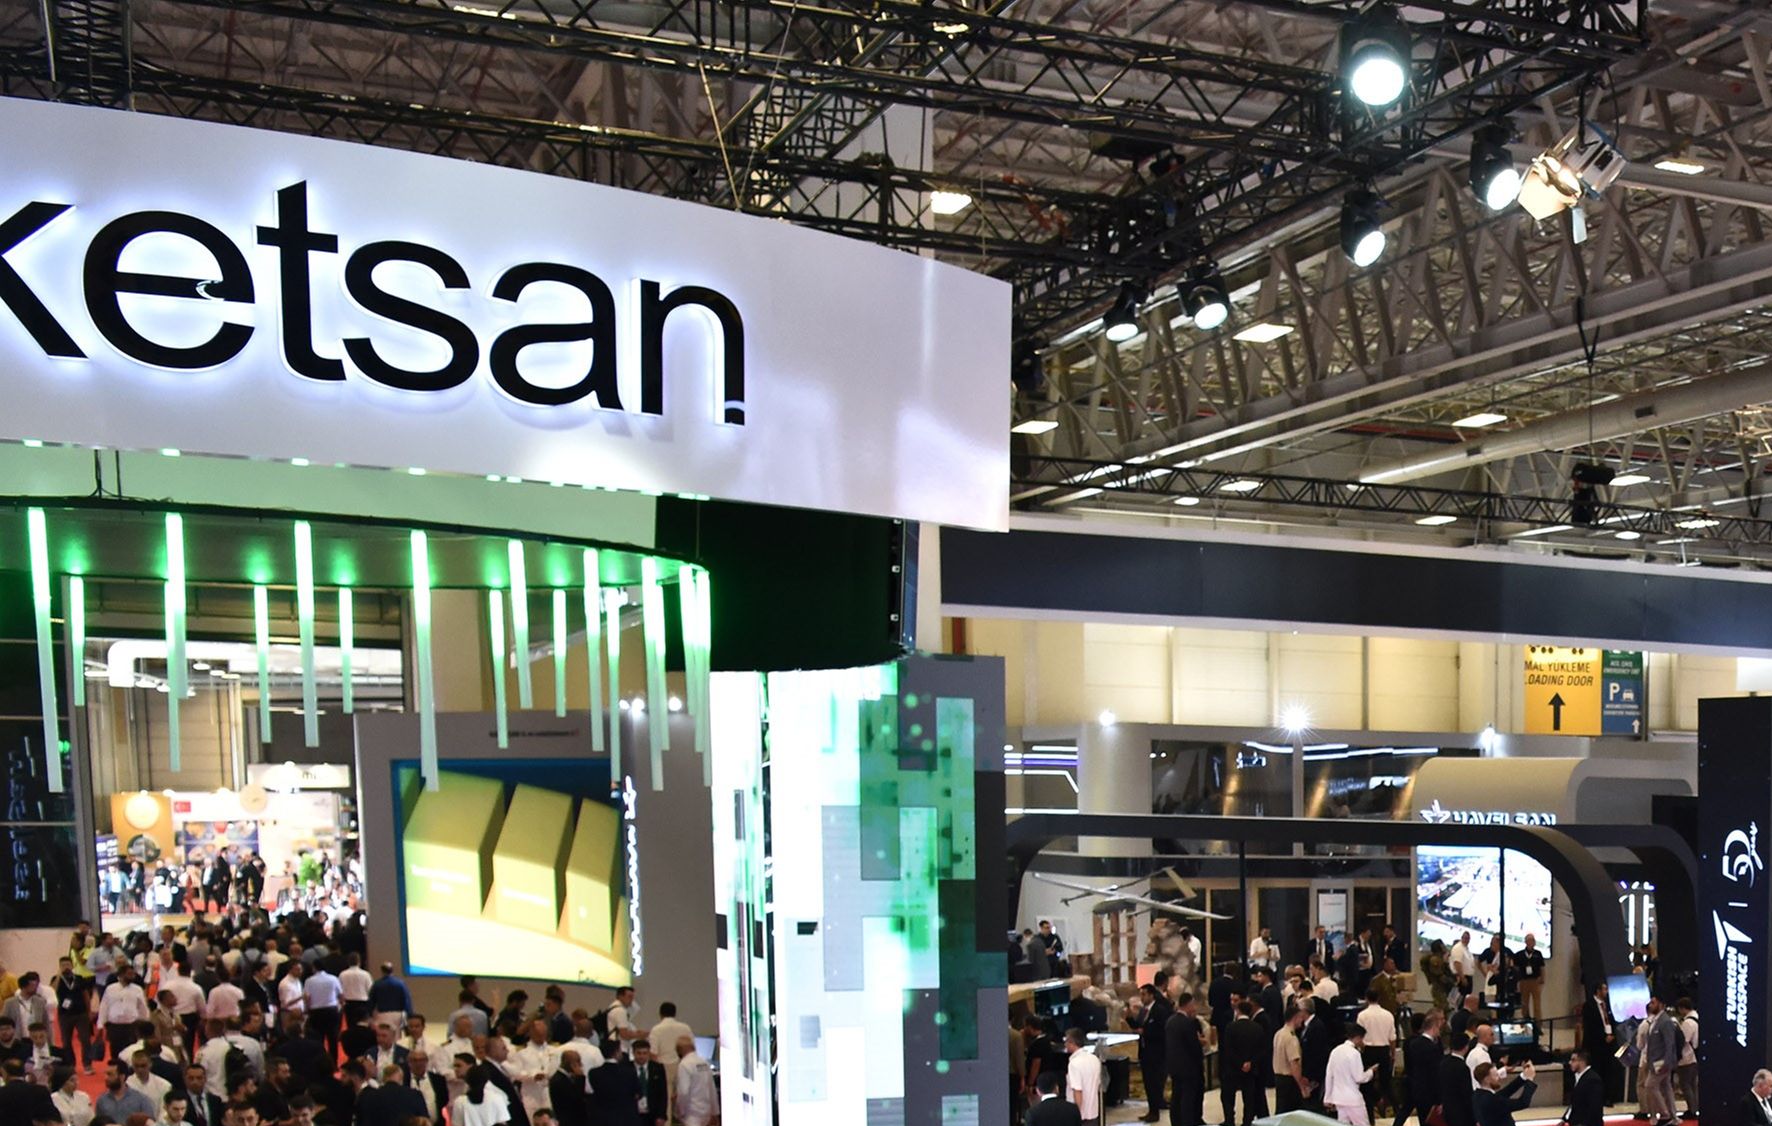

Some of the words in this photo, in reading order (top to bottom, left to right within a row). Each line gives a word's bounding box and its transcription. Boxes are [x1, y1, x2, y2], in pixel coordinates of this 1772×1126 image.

[1567, 676, 1593, 686] DOOR
[1610, 682, 1620, 701] P
[1726, 945, 1738, 1022] TURKISH
[1736, 953, 1748, 1048] AEROSPACE
